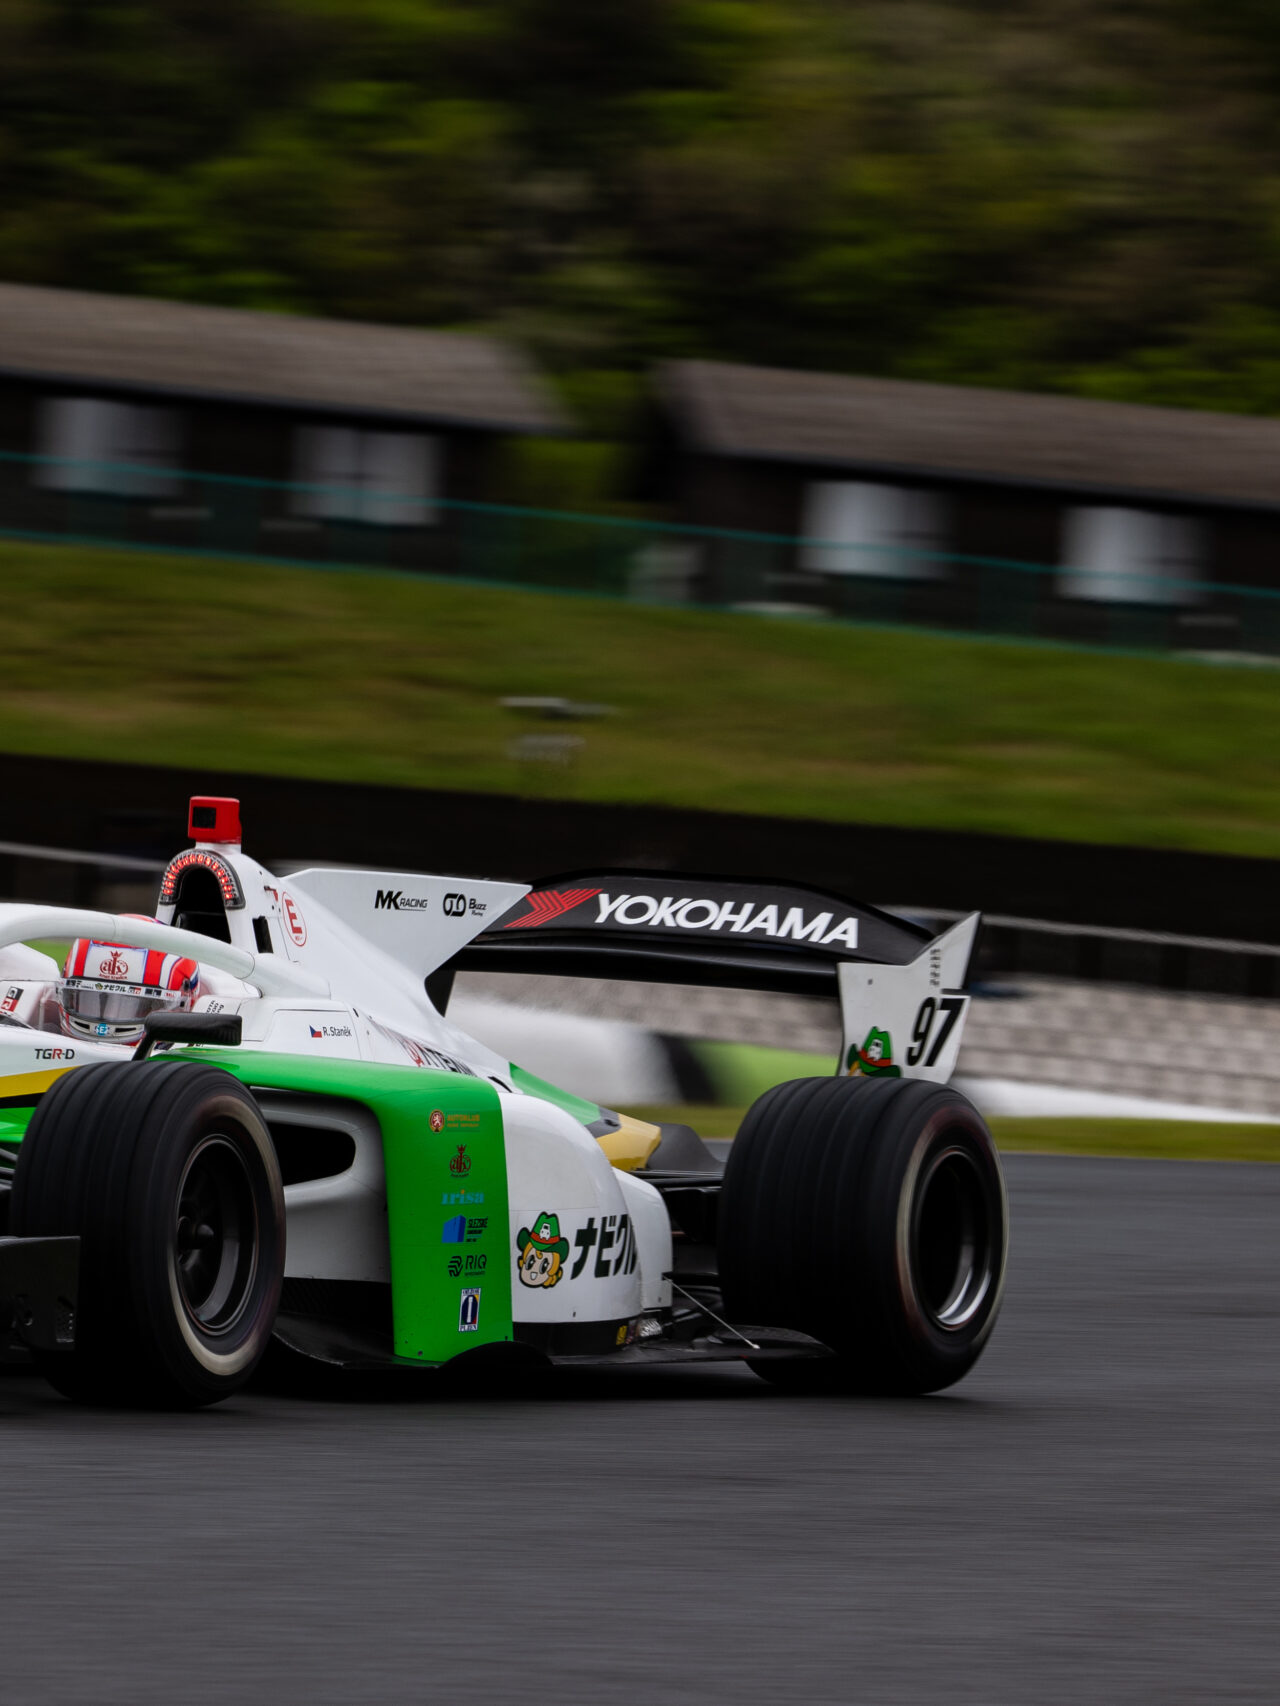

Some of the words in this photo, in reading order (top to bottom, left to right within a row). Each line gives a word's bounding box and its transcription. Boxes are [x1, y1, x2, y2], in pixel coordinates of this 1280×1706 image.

[594, 893, 859, 949] YOKOHAMA
[35, 1048, 75, 1060] TGR-D
[906, 997, 967, 1067] 97
